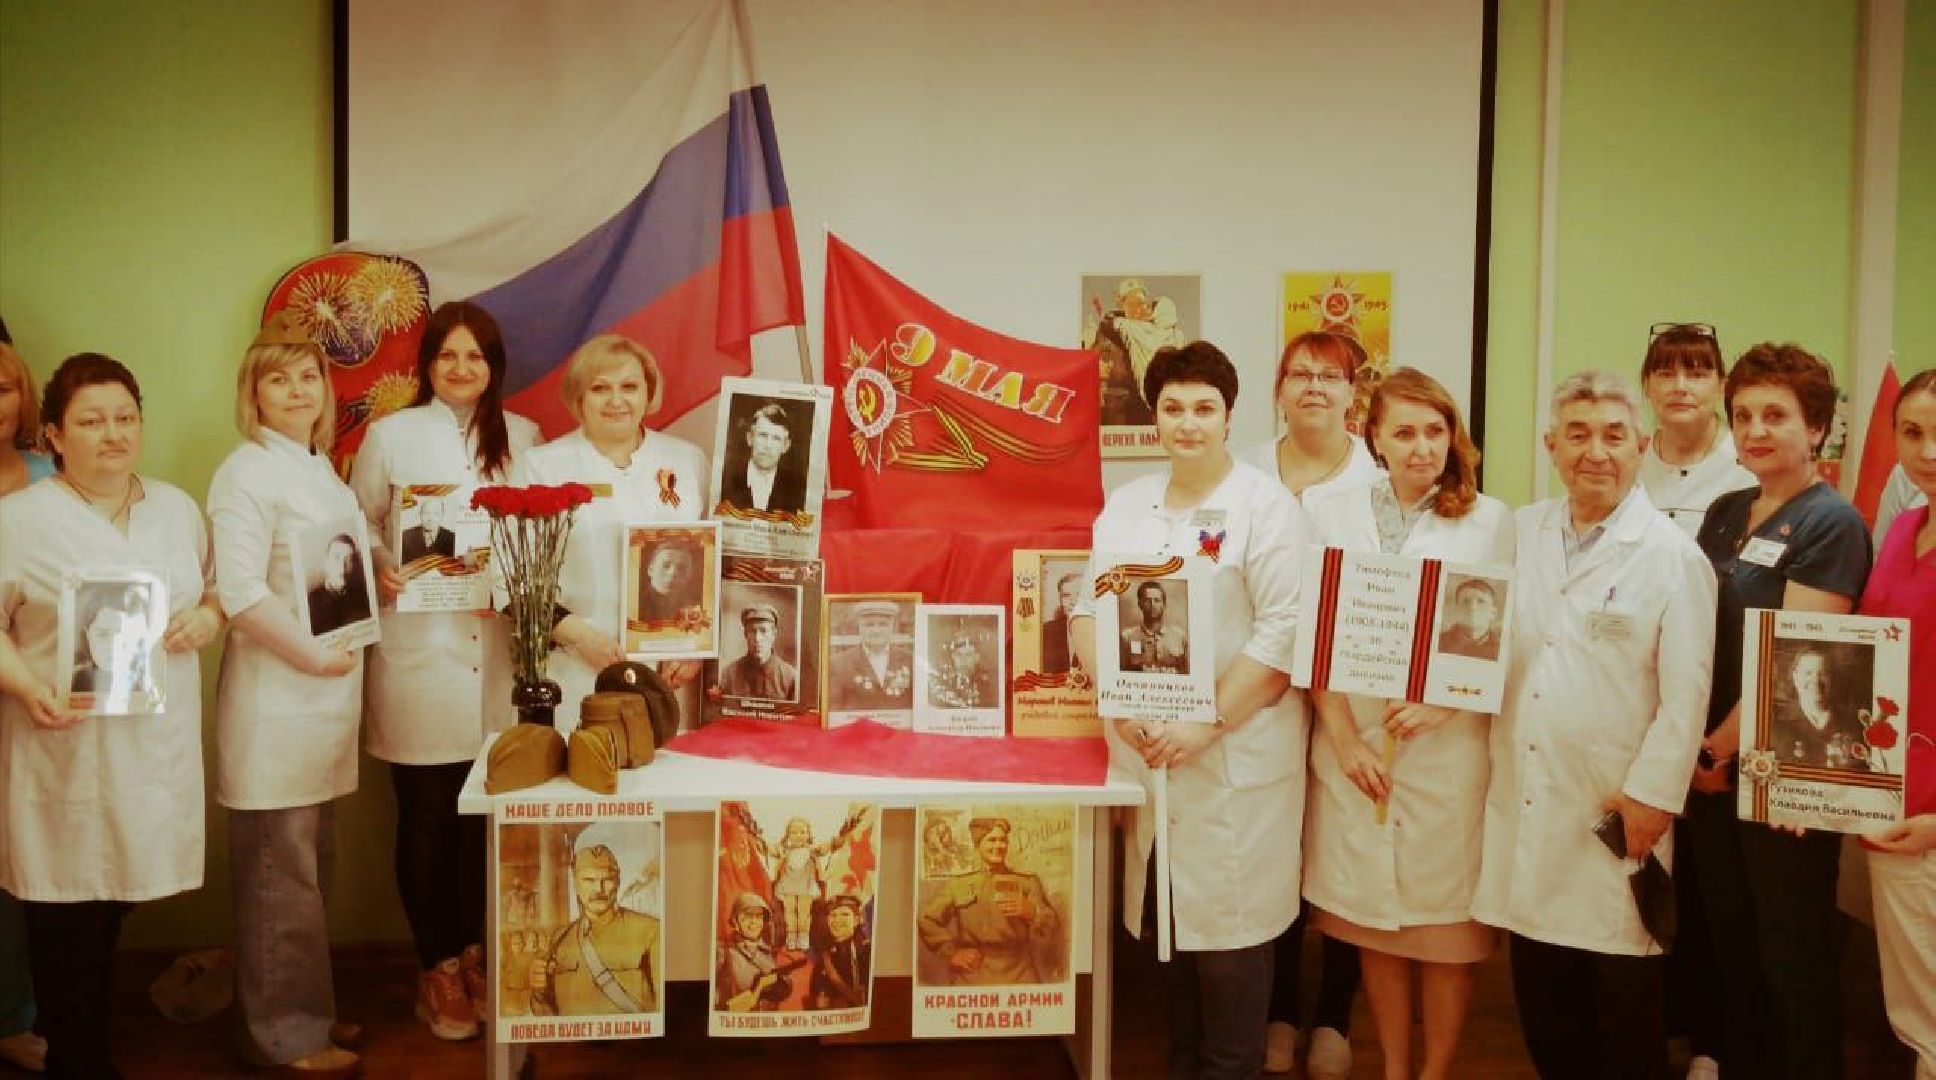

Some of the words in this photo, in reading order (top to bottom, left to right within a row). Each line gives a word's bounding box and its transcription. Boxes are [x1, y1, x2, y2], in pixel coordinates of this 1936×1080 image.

[889, 323, 937, 367] 9
[934, 348, 1077, 424] МАЯ
[505, 803, 551, 819] НАШЕ
[555, 802, 593, 817] ДЕЛО
[597, 800, 655, 817] ПРАВОЕ
[1768, 797, 1821, 813] Клавдия
[1821, 803, 1897, 822] Васильевна
[923, 991, 1000, 1009] КРАСНОЙ
[1006, 991, 1064, 1007] АРМИИ
[511, 1023, 556, 1041] ПОБЕДА
[558, 1021, 593, 1038] БУДЕТ
[597, 1021, 612, 1037] ЗА
[614, 1019, 652, 1036] НАМИ
[737, 1015, 778, 1029] БУДЕШЬ
[781, 1014, 808, 1029] ЖИТЬ
